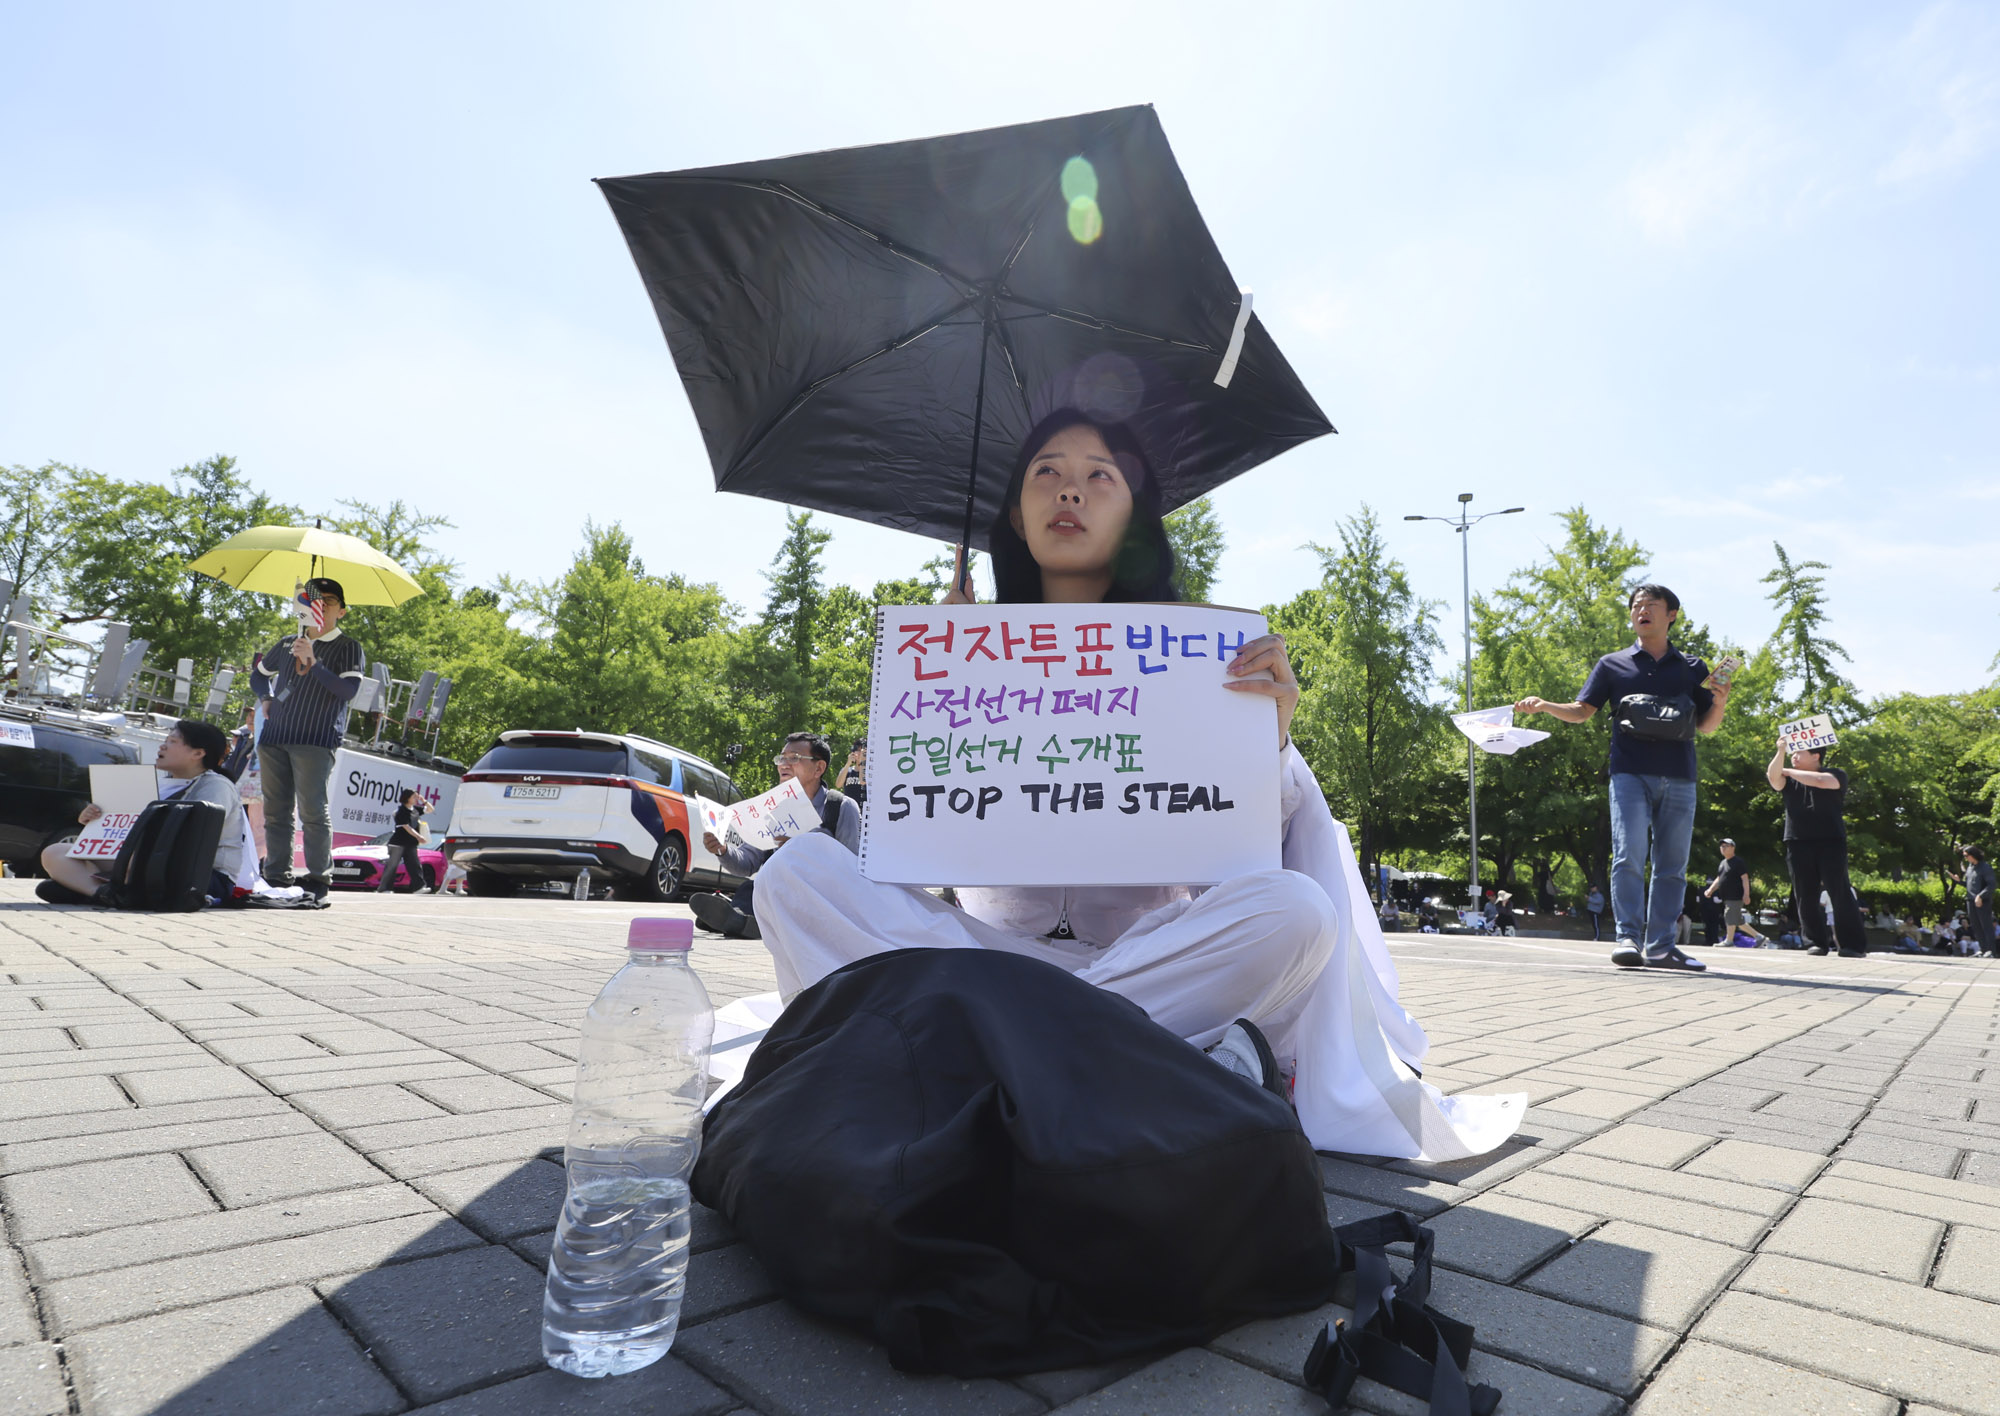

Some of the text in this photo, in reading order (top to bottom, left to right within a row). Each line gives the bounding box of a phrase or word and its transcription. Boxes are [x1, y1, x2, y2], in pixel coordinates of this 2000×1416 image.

[897, 620, 1245, 681] 전자투표 반대
[1784, 719, 1821, 735] CALL
[1791, 728, 1818, 742] FOR
[889, 732, 1145, 776] 당일선거 수개표
[888, 782, 1235, 821] STOP THE STEAL
[102, 814, 140, 829] STOP
[103, 828, 128, 839] THE
